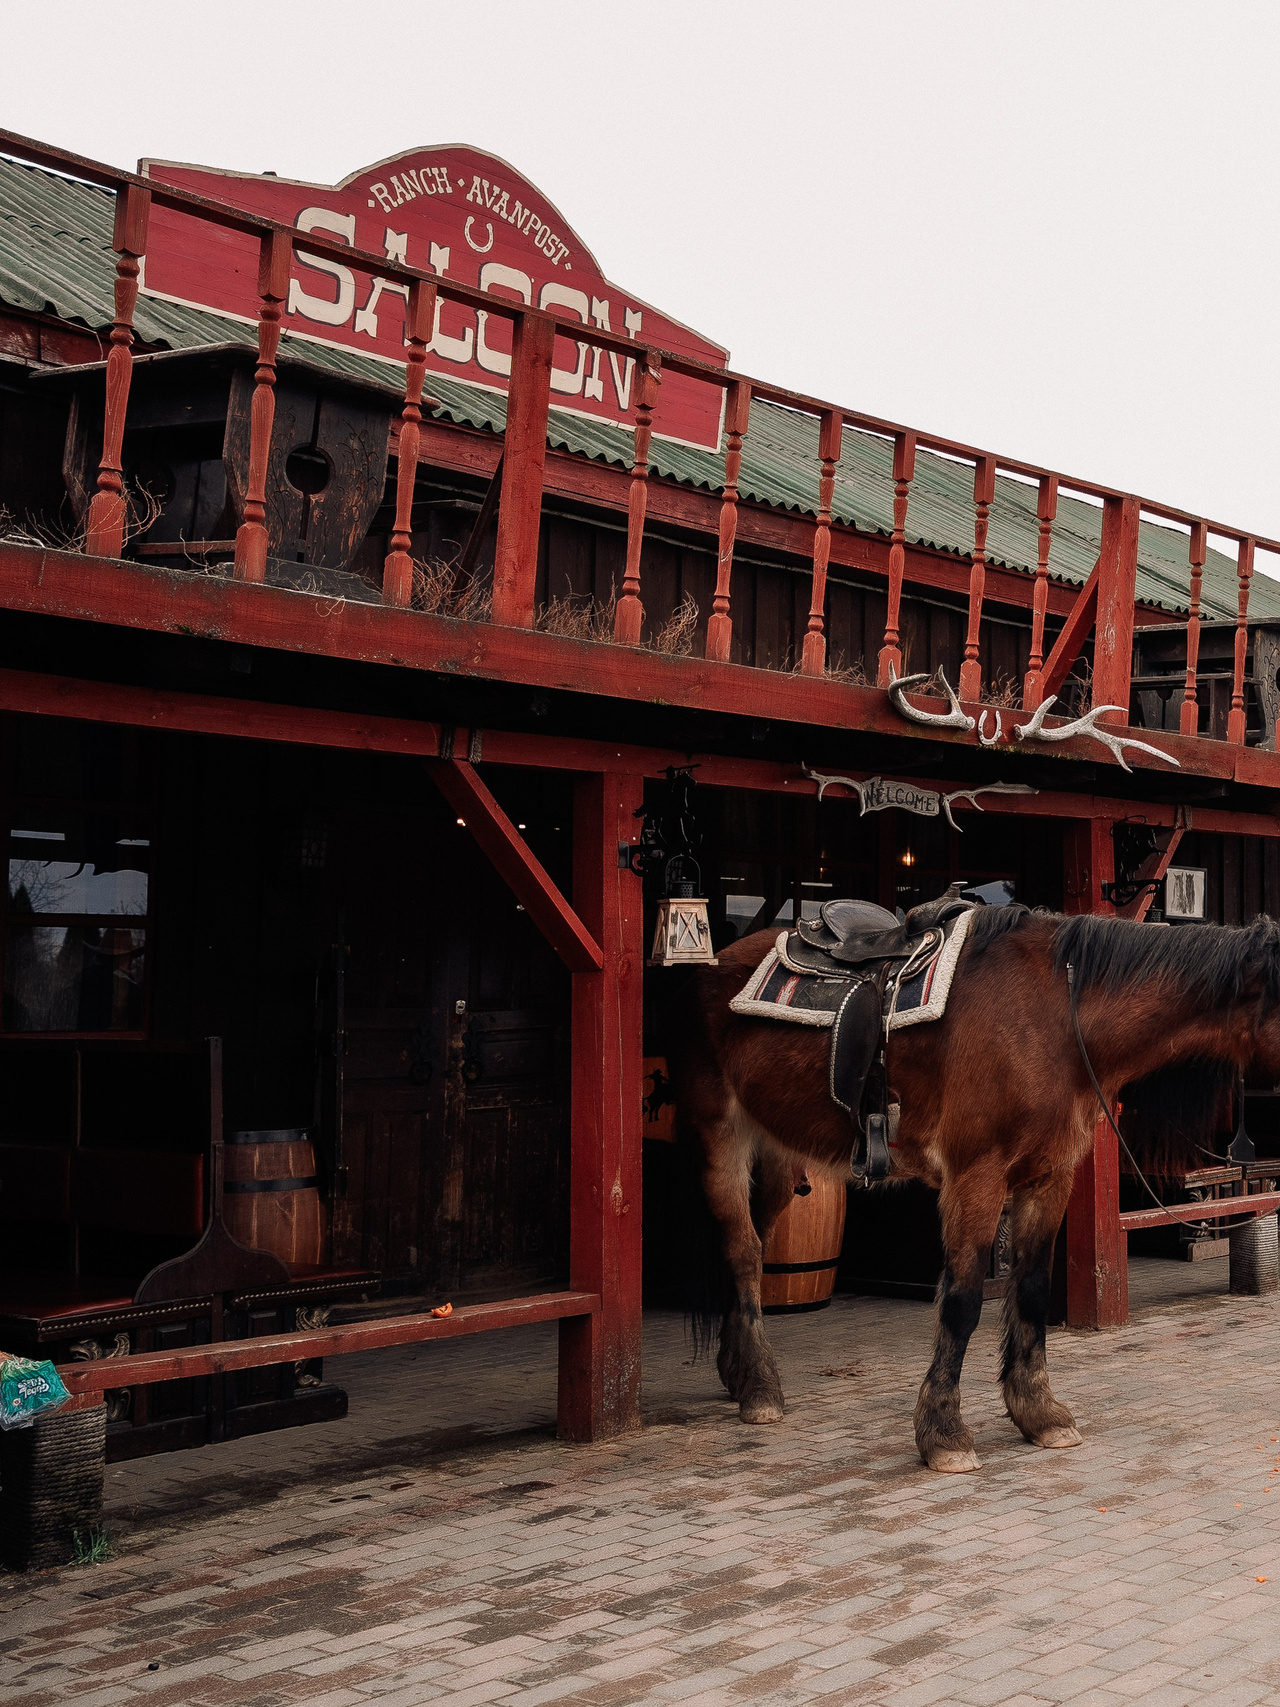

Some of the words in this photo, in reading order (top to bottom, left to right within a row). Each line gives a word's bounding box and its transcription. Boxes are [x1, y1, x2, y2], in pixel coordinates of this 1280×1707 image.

[370, 167, 453, 214] RANCH
[466, 175, 570, 266] AVANPOST
[863, 782, 936, 811] WELCOME
